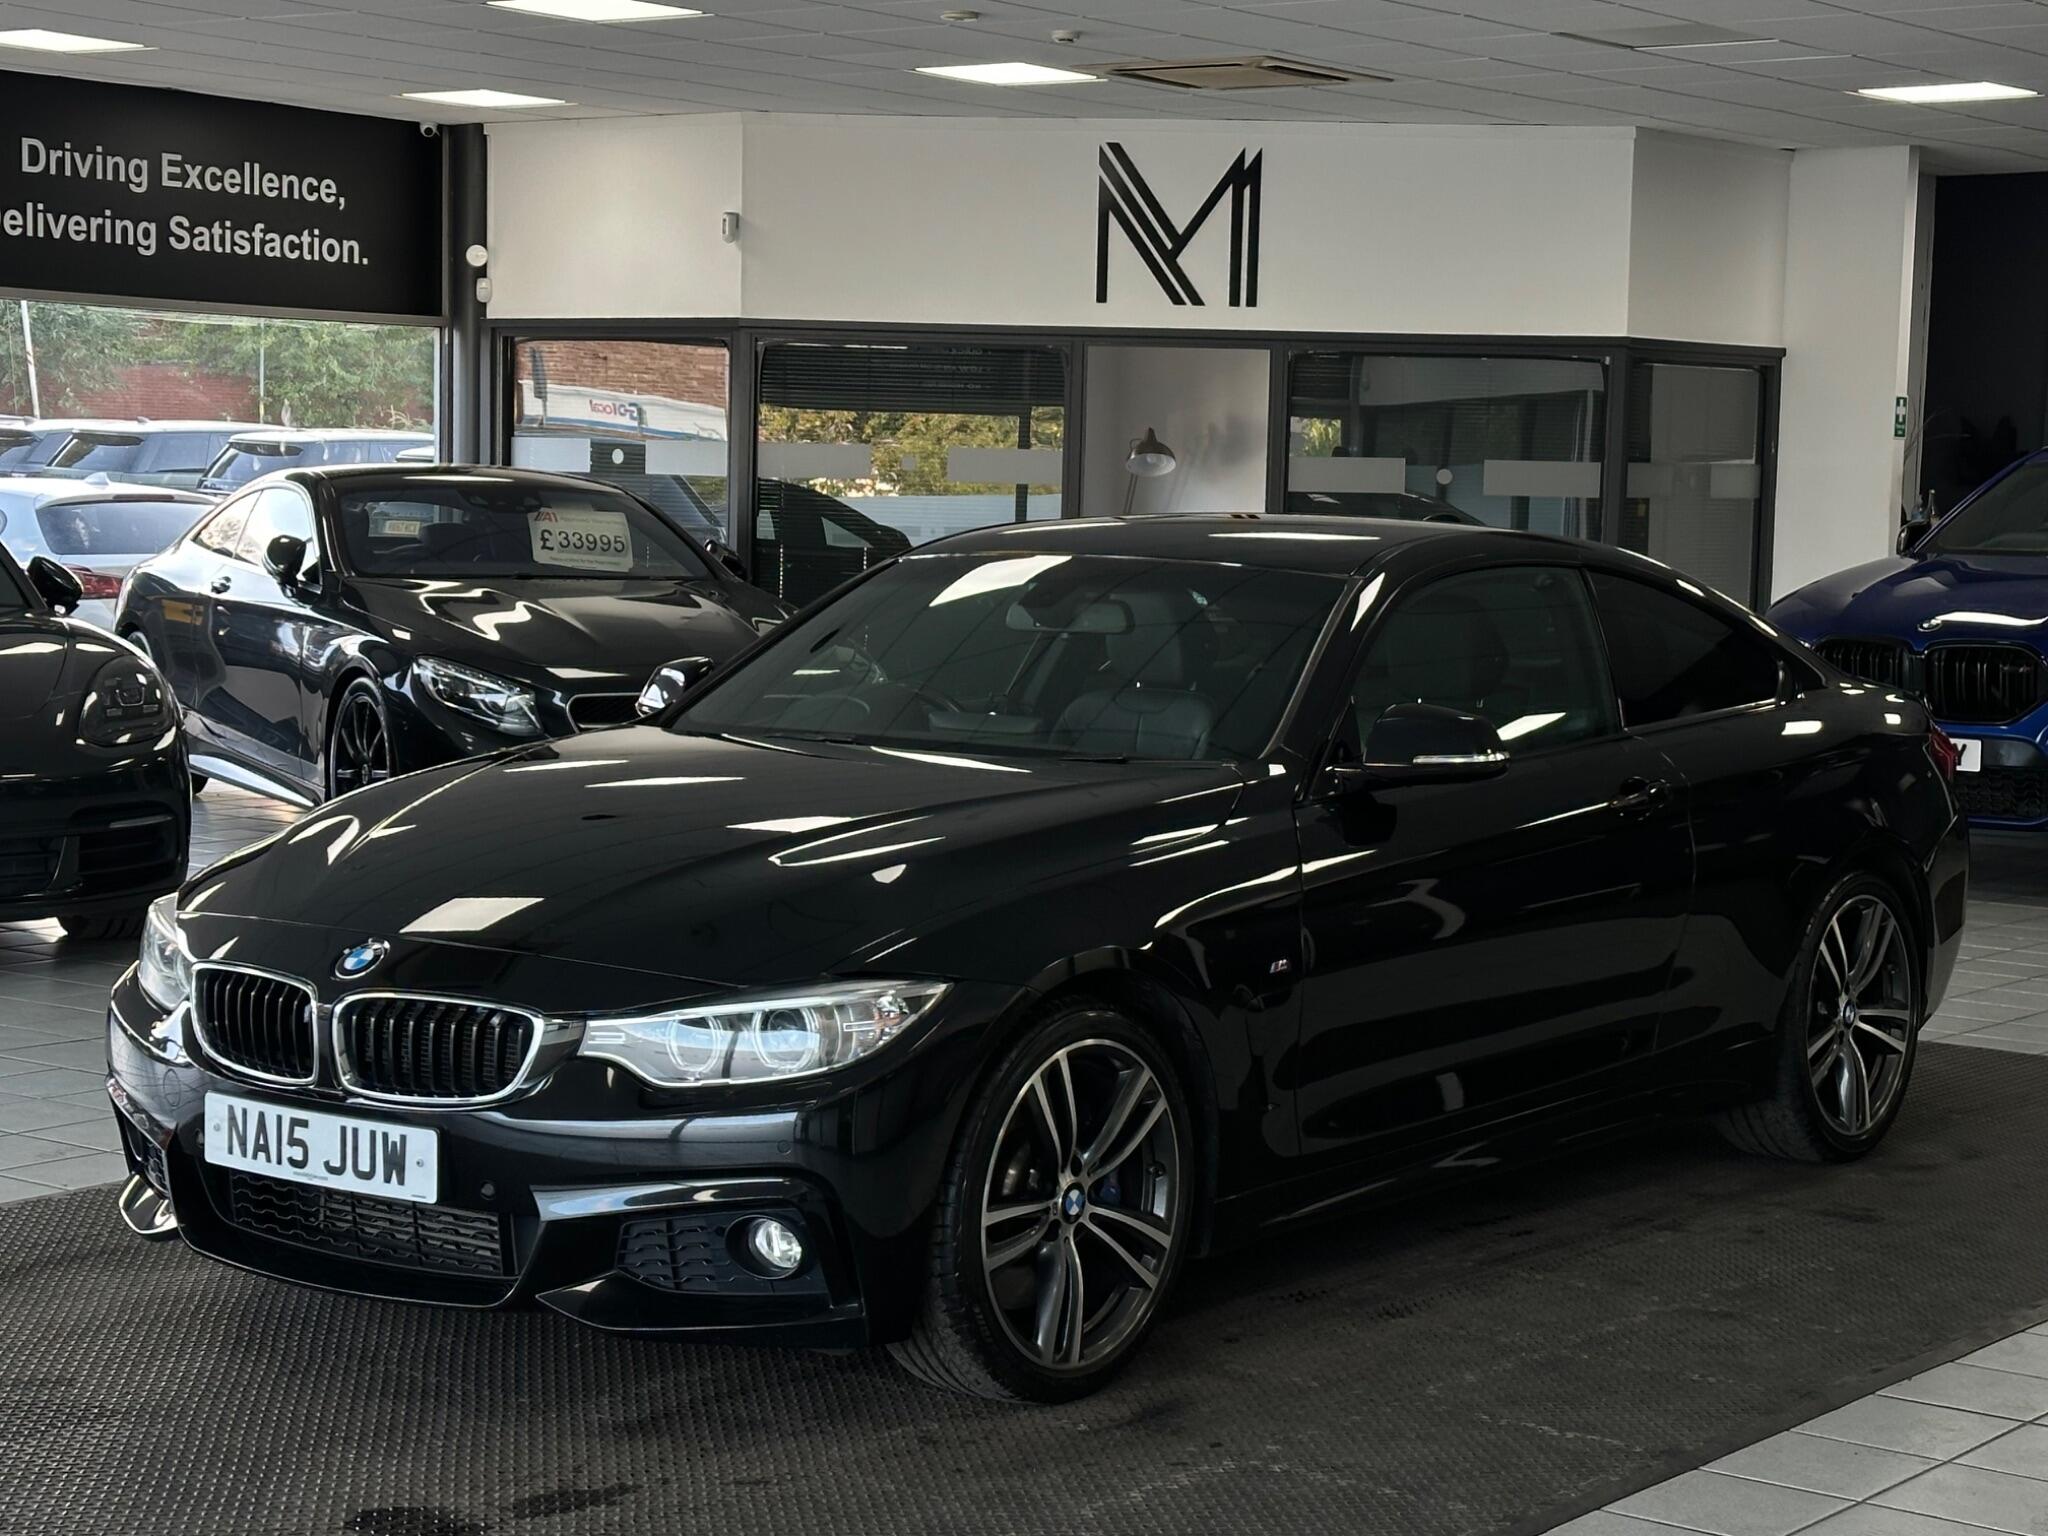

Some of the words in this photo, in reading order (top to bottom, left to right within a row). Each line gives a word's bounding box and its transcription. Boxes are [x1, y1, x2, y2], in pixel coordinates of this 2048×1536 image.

[21, 137, 149, 193] Driving
[161, 153, 346, 210] Excellence,
[0, 202, 157, 256] elivering
[168, 215, 369, 265] Satisfaction.
[540, 529, 625, 553] £33995
[227, 1104, 310, 1170] NA15
[323, 1125, 407, 1187] JUW
